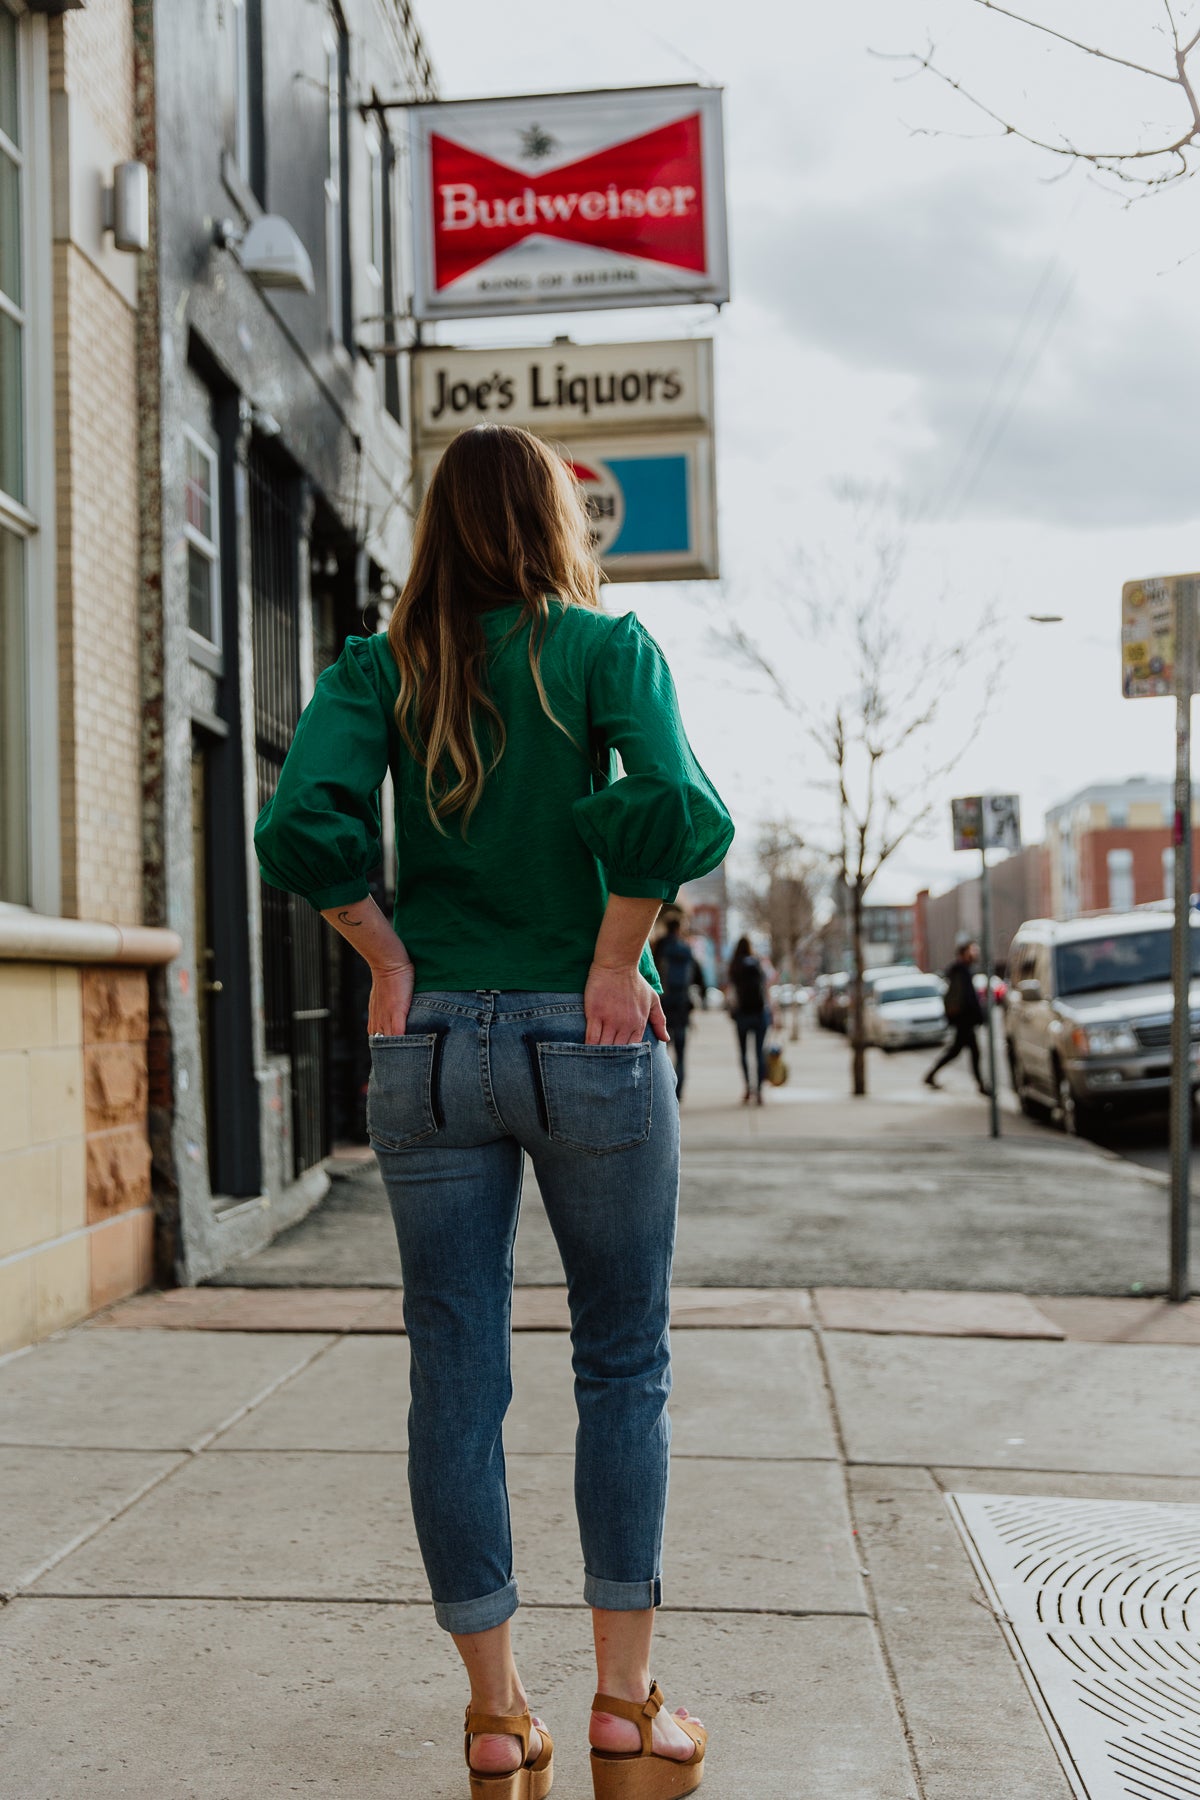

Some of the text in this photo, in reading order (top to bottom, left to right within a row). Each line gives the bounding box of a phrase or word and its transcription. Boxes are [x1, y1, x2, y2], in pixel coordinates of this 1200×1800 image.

[439, 182, 697, 231] Budweiser
[431, 364, 682, 419] Joe's Liquors
